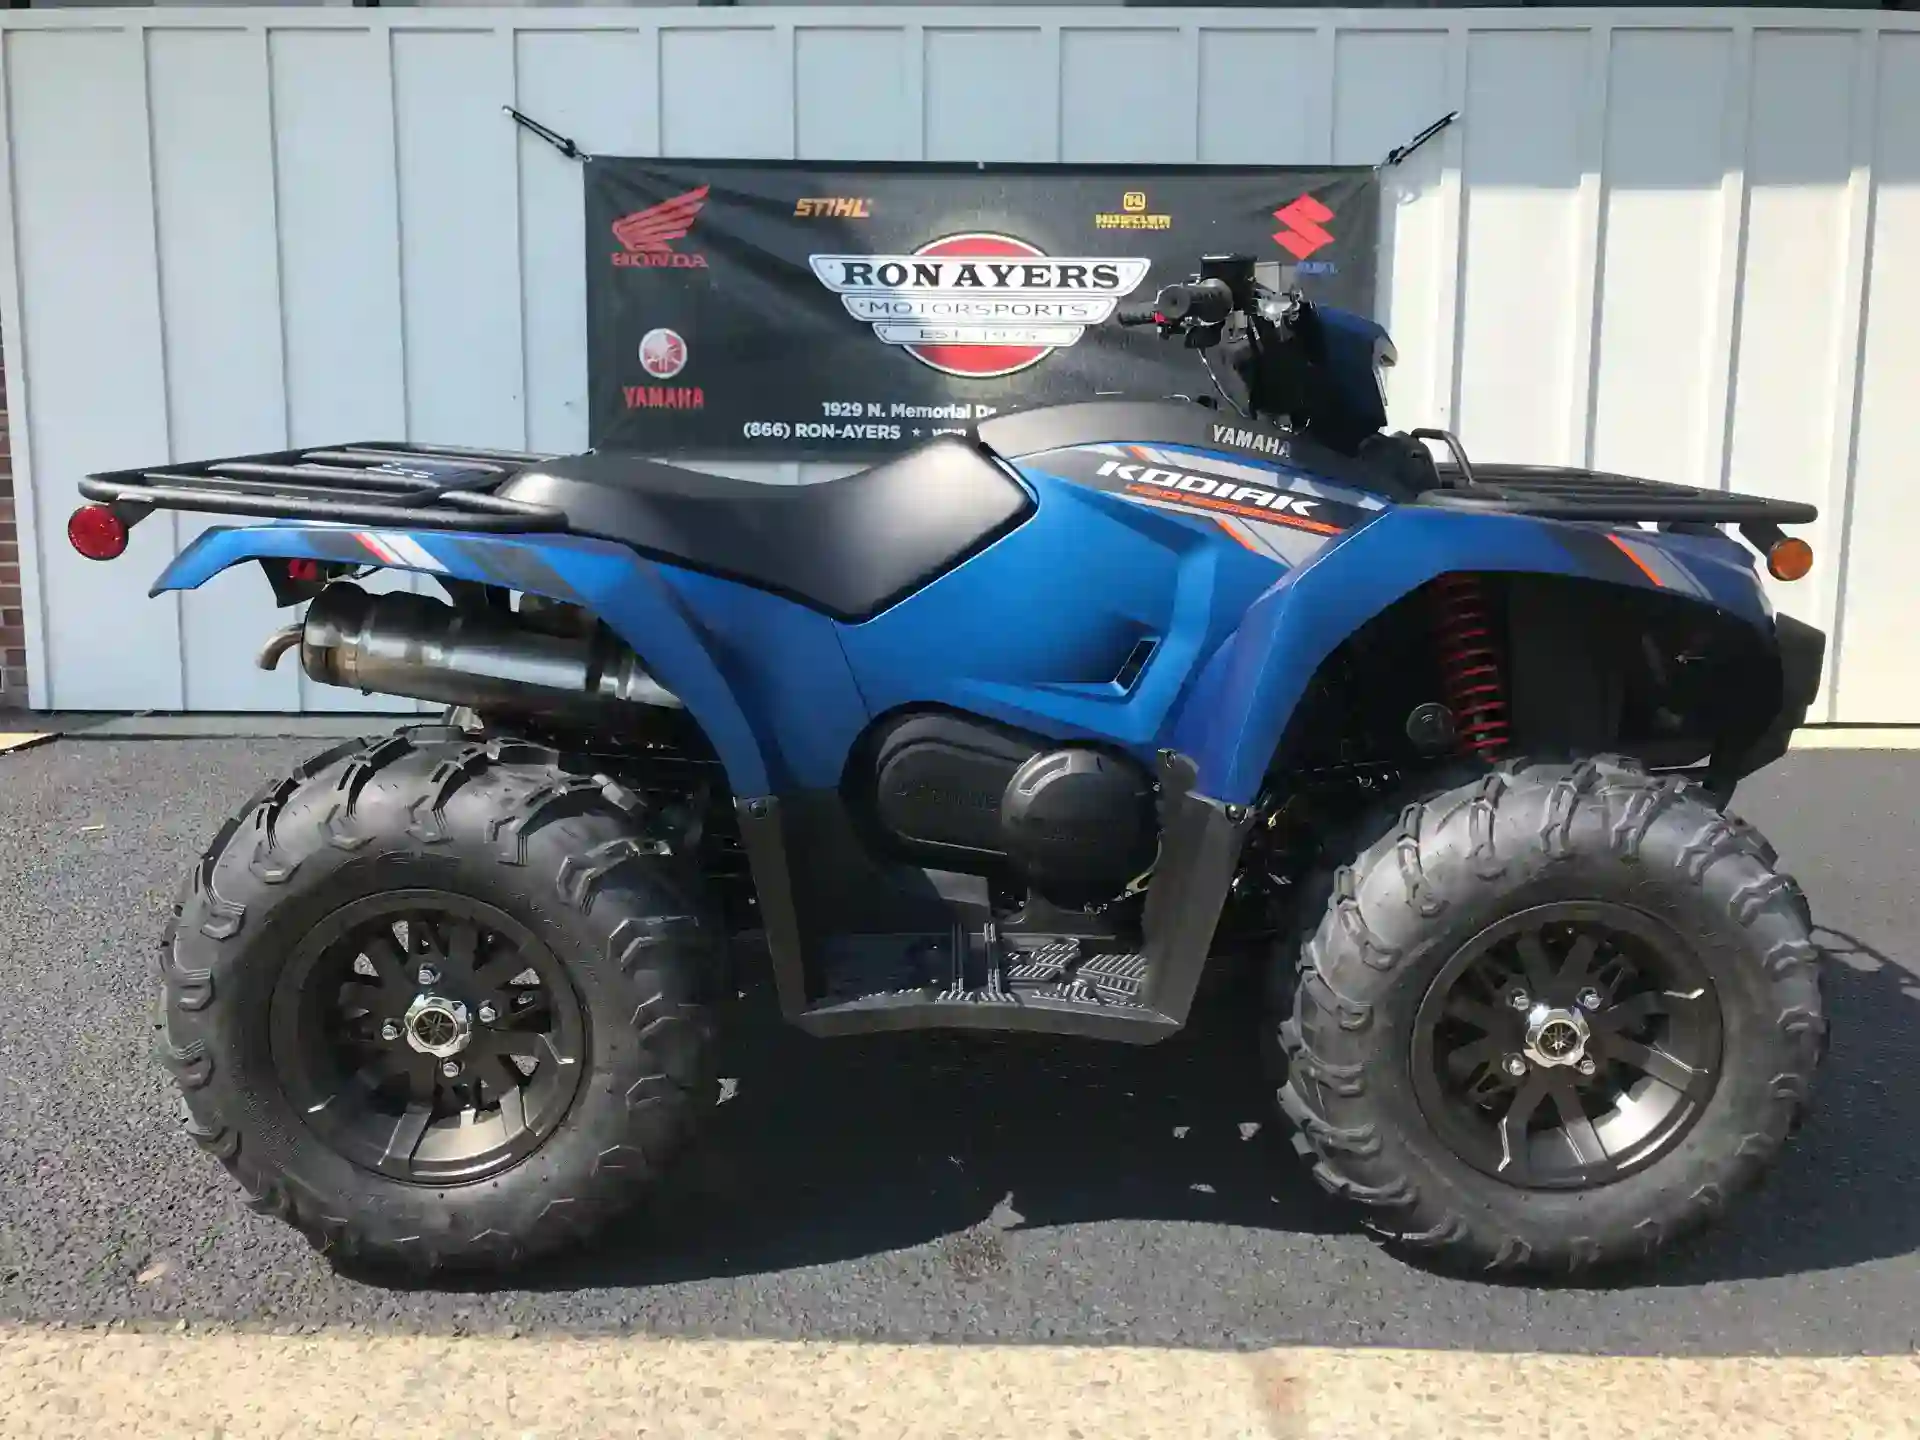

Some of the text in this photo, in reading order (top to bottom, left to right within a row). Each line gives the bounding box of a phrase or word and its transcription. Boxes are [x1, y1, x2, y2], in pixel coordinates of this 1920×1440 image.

[793, 198, 870, 218] STIHL
[611, 252, 709, 268] HONDA
[840, 263, 1120, 289] RON AYERS
[869, 301, 1088, 317] MOTORSPORTS
[622, 386, 704, 410] YAMAHA
[822, 402, 863, 416] 1929
[868, 403, 886, 417] N.
[891, 403, 971, 418] Memorial
[743, 422, 901, 439] (866) RON-AYERS
[1212, 424, 1292, 458] YAMAHA
[1096, 461, 1321, 516] KODIAK
